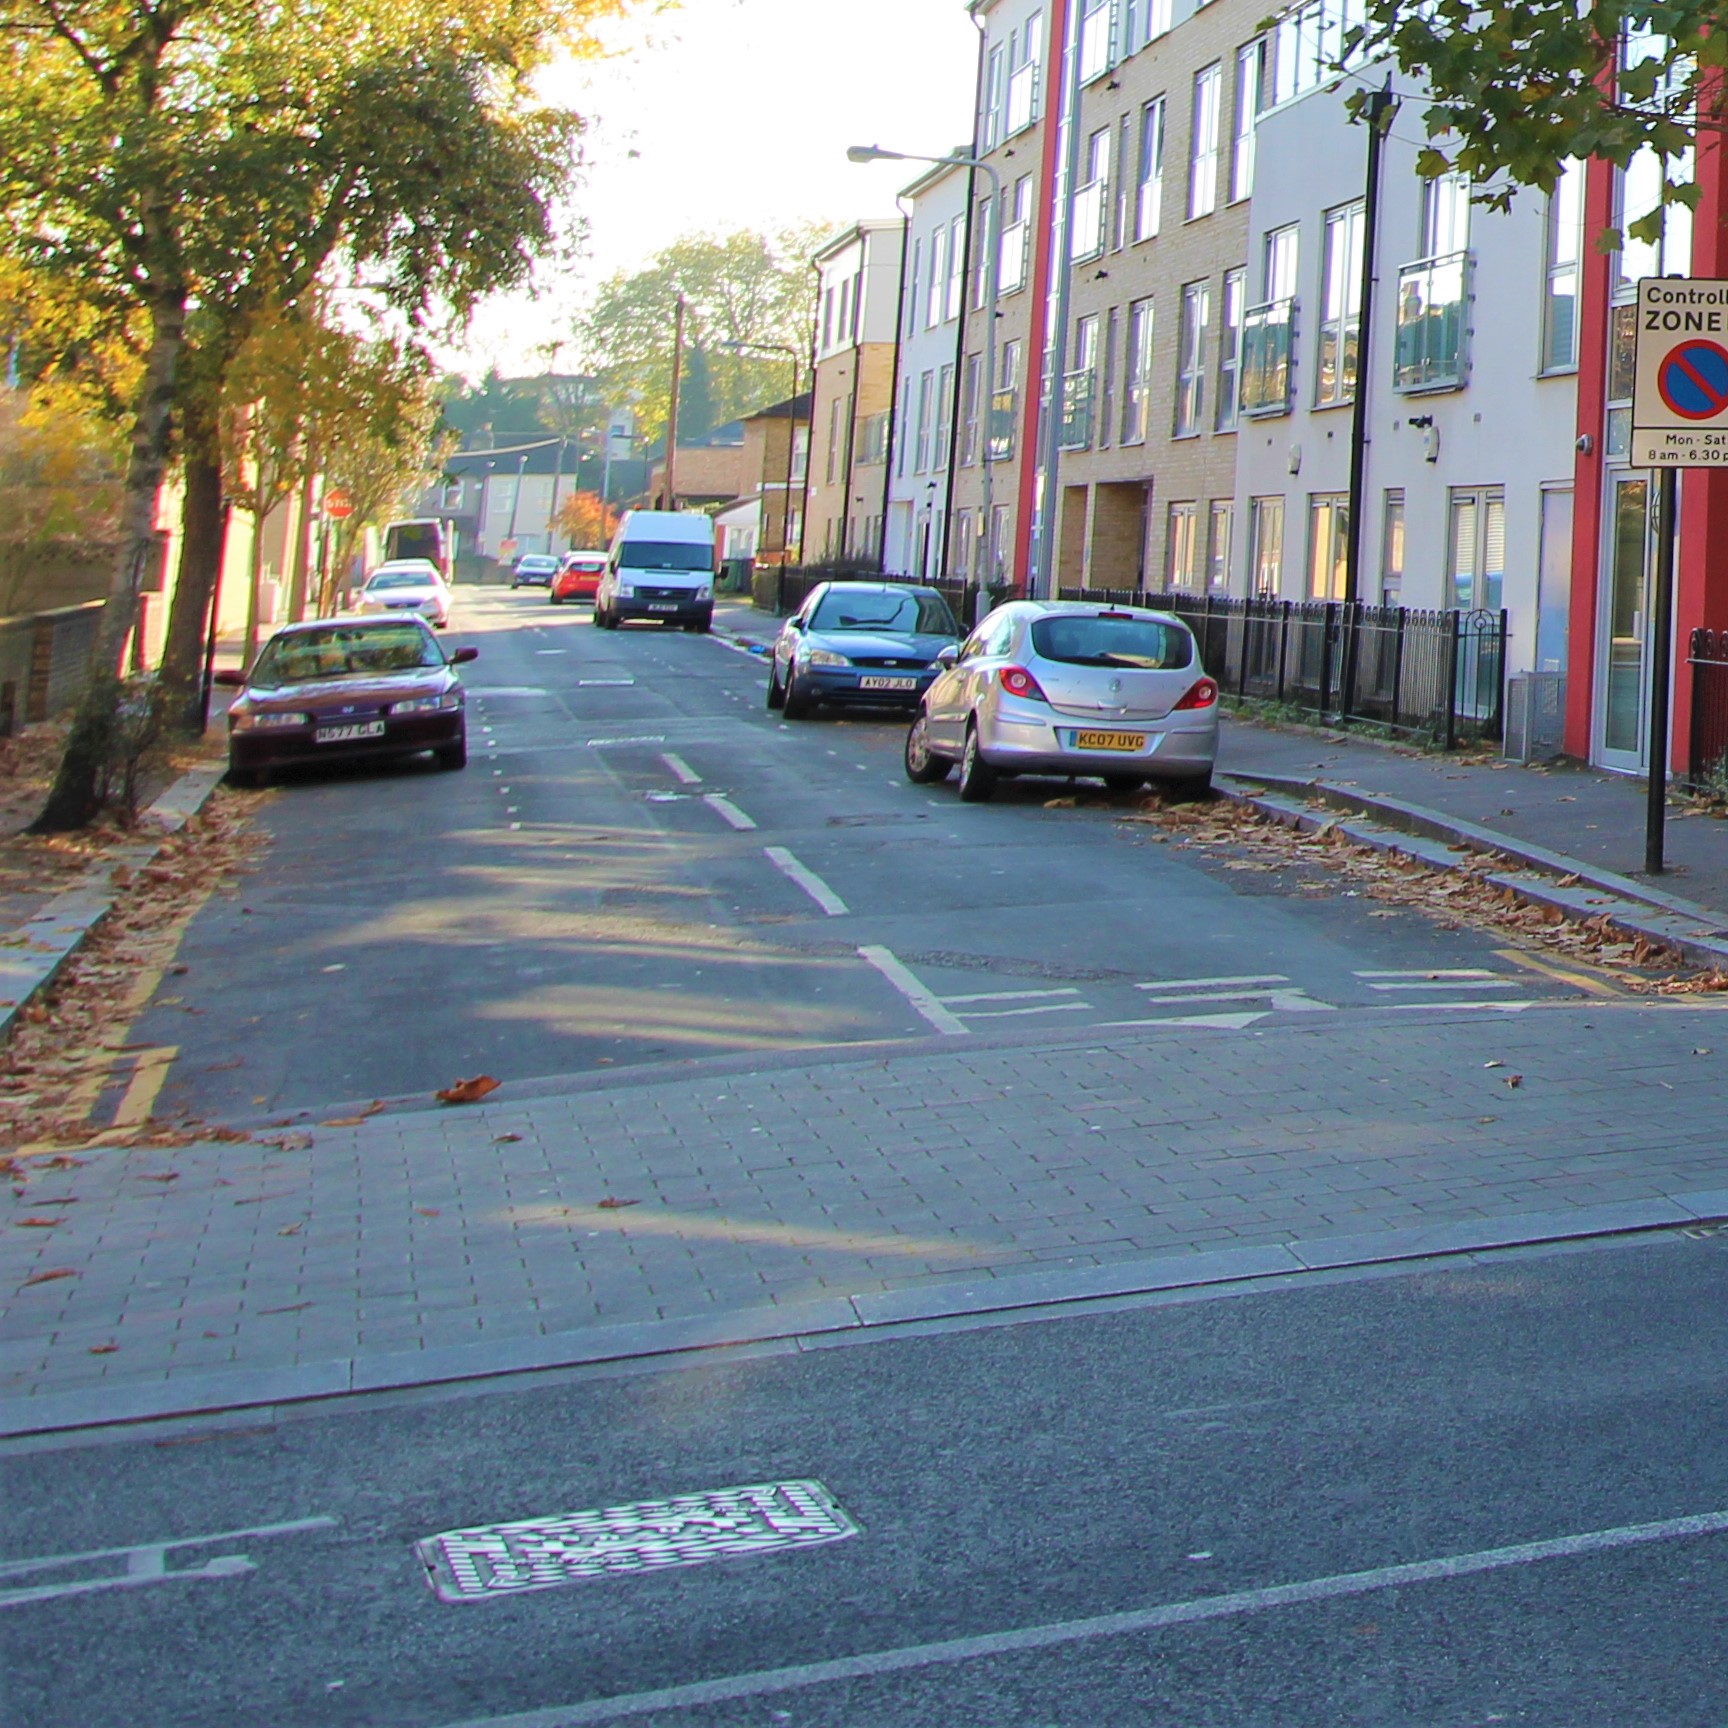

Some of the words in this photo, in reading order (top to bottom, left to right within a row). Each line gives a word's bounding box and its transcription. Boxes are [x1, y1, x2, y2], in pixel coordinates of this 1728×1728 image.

[1645, 310, 1722, 332] ZONE
[1665, 434, 1694, 446] Mon
[1704, 434, 1727, 446] Sat
[1648, 449, 1657, 460] 8
[1659, 452, 1679, 461] am
[1689, 449, 1721, 461] 6.30
[865, 677, 891, 688] AY02
[1079, 732, 1115, 746] KC07
[1118, 733, 1145, 747] UVG
